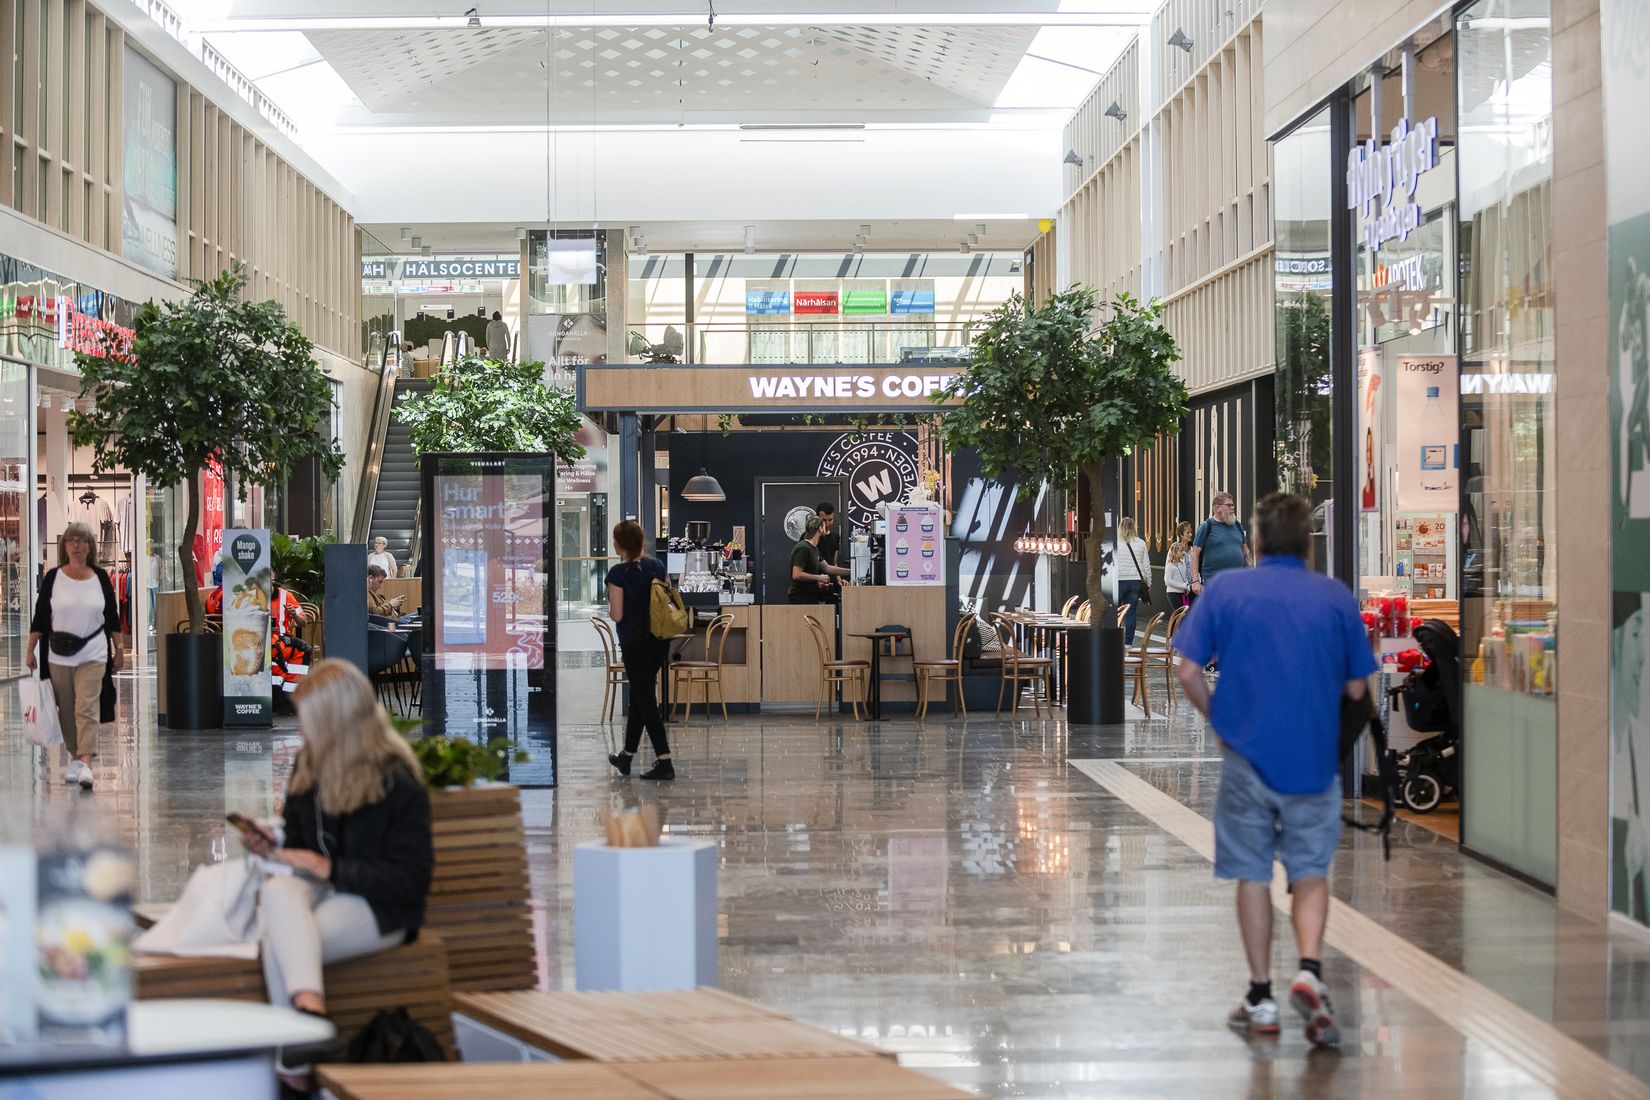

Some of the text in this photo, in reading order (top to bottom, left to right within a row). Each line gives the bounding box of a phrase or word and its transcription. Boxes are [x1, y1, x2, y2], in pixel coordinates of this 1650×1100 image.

[572, 355, 590, 366] för
[1403, 361, 1445, 374] Torstig?
[749, 375, 876, 398] WAYNE'S
[443, 484, 481, 501] Hur
[236, 540, 256, 550] Mango
[237, 551, 255, 560] shake
